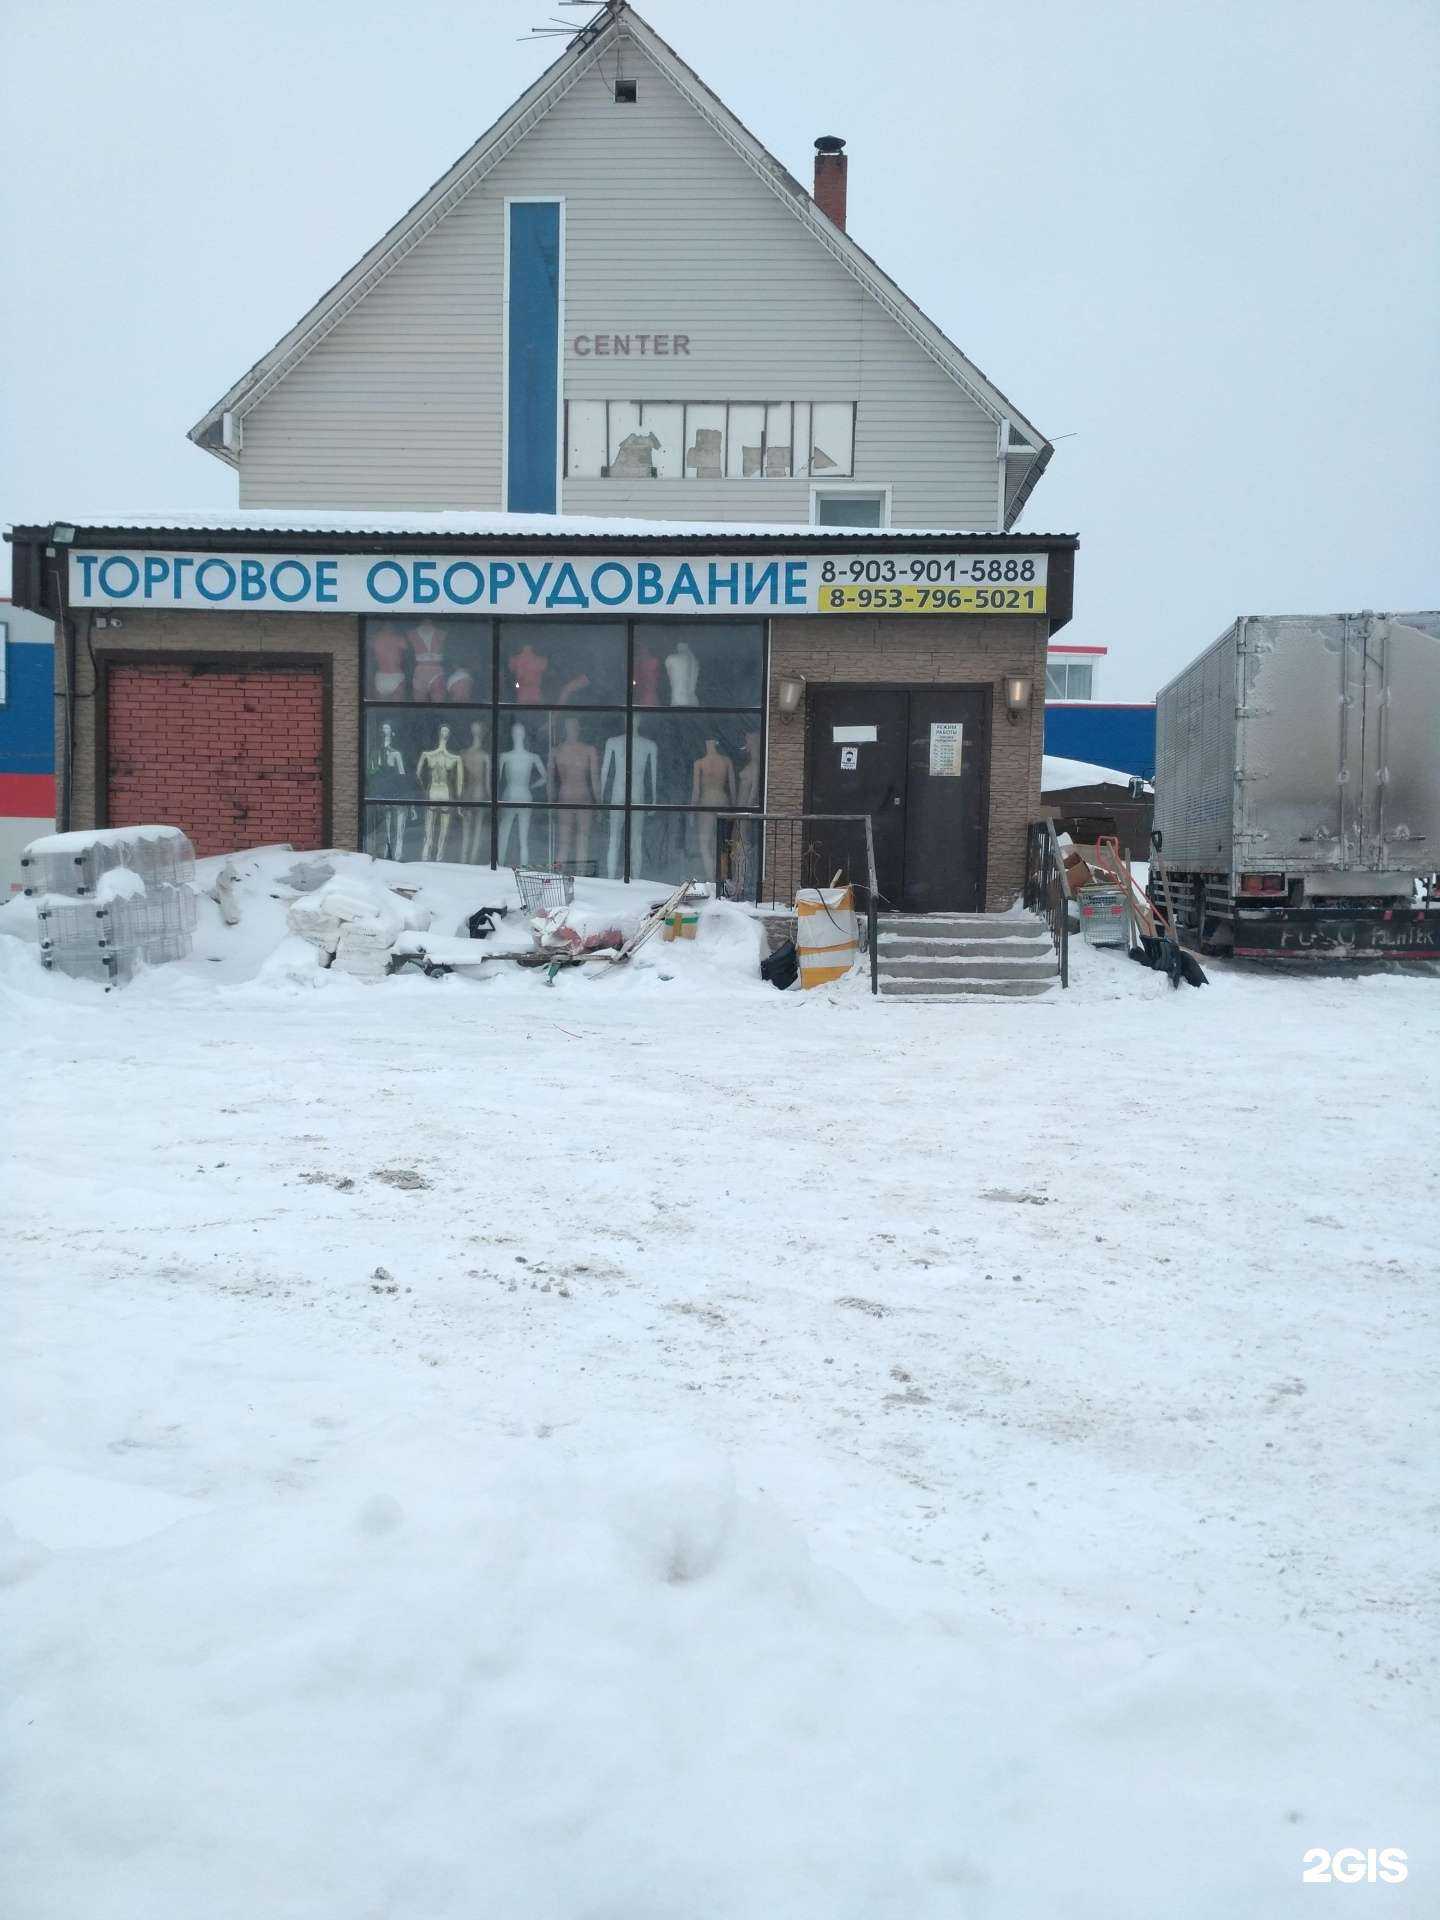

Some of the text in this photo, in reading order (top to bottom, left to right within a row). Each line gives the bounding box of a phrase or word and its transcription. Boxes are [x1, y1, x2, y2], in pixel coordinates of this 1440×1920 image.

[574, 334, 691, 356] CENTER
[76, 555, 807, 609] ТОРГОВОЕ ОБОРУДОВАНИЕ
[821, 559, 1035, 583] 8-903-901-5888
[830, 588, 1034, 609] 8-953-796-5021
